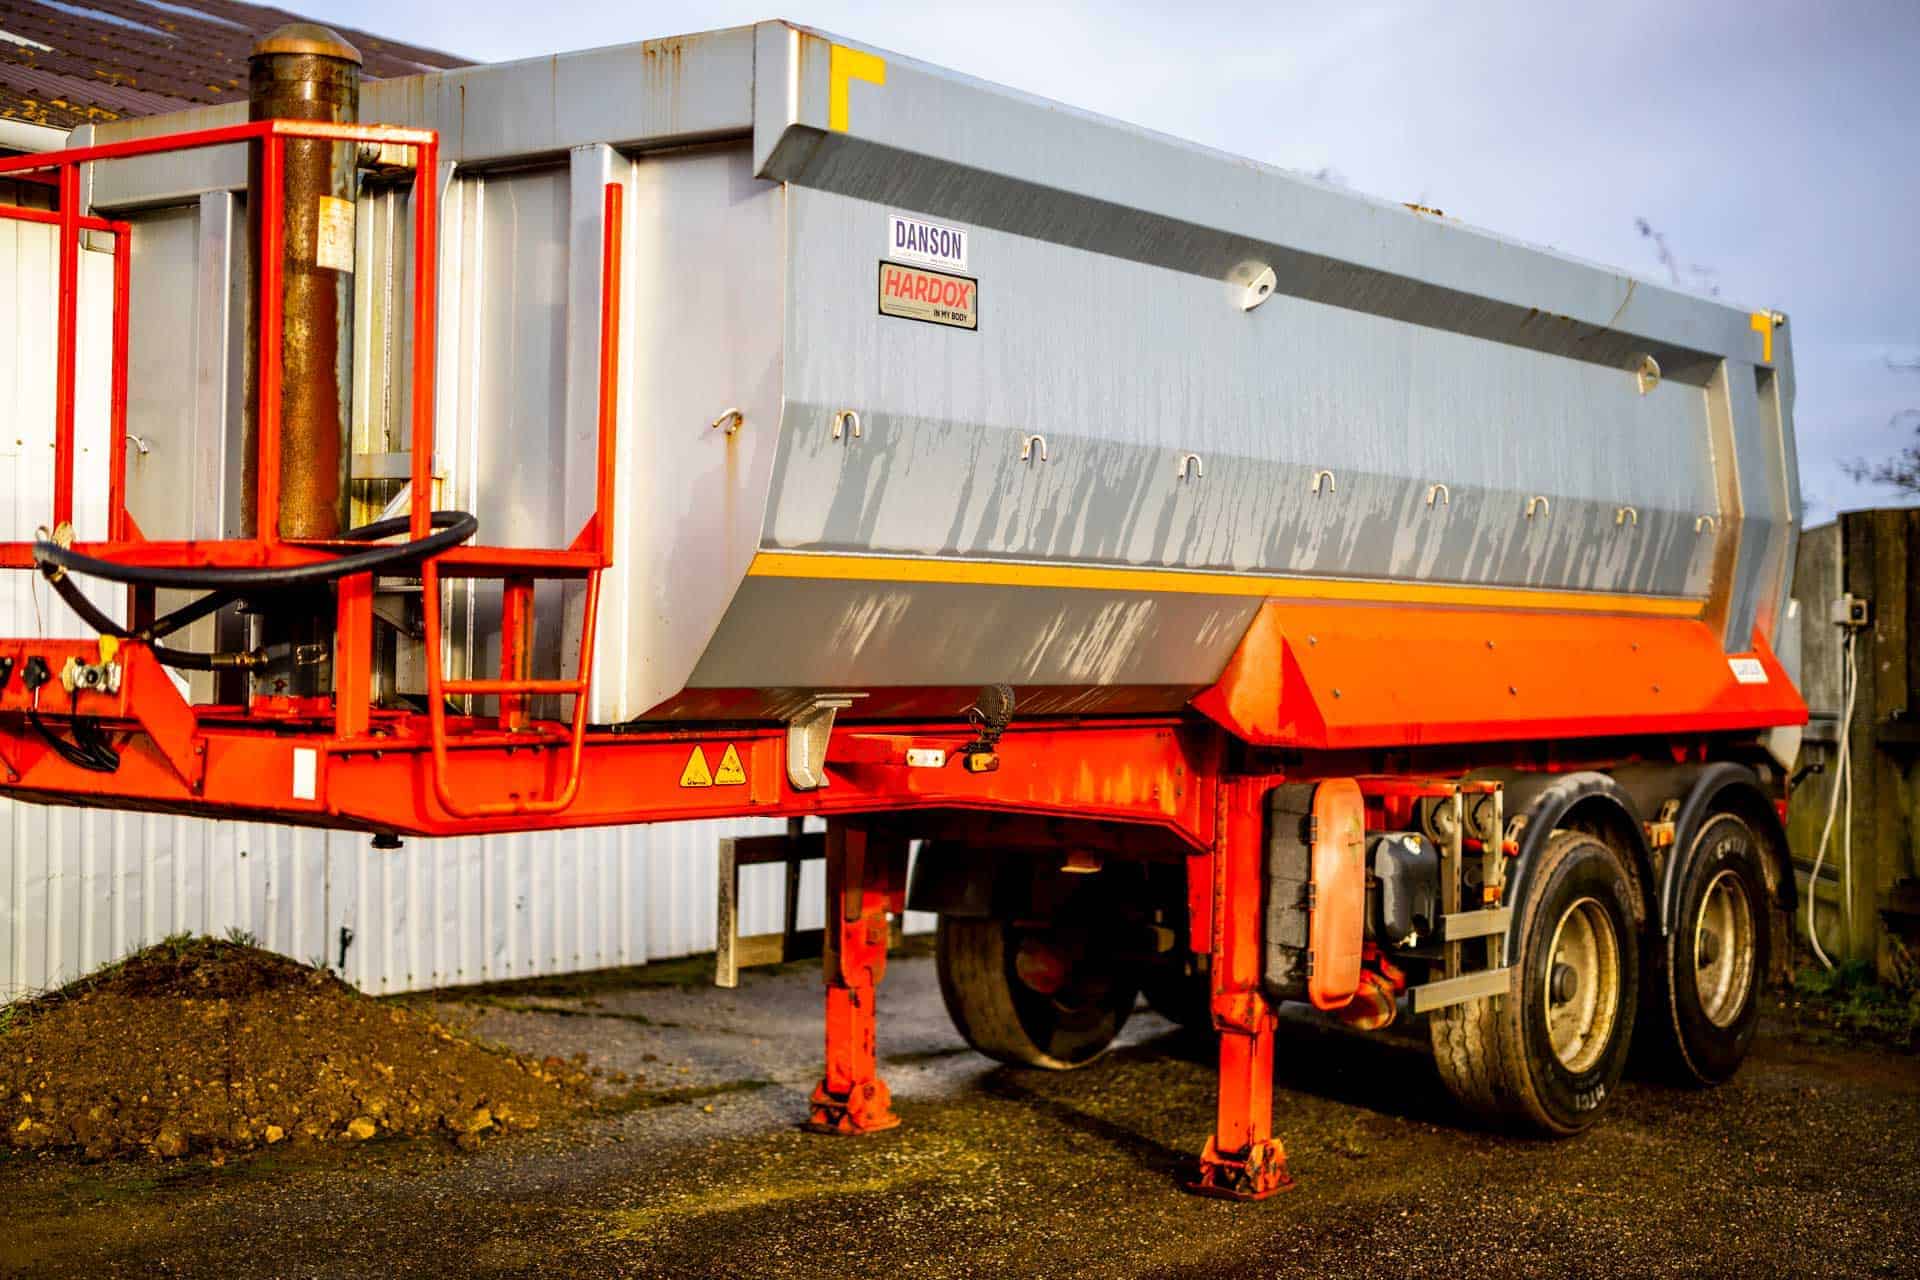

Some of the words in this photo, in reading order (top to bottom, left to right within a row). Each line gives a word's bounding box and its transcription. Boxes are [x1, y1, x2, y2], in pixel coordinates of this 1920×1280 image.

[896, 220, 962, 260] DANSON
[885, 269, 970, 310] HARDOX
[933, 309, 941, 318] IN
[941, 310, 951, 319] MY
[951, 311, 968, 322] BODY
